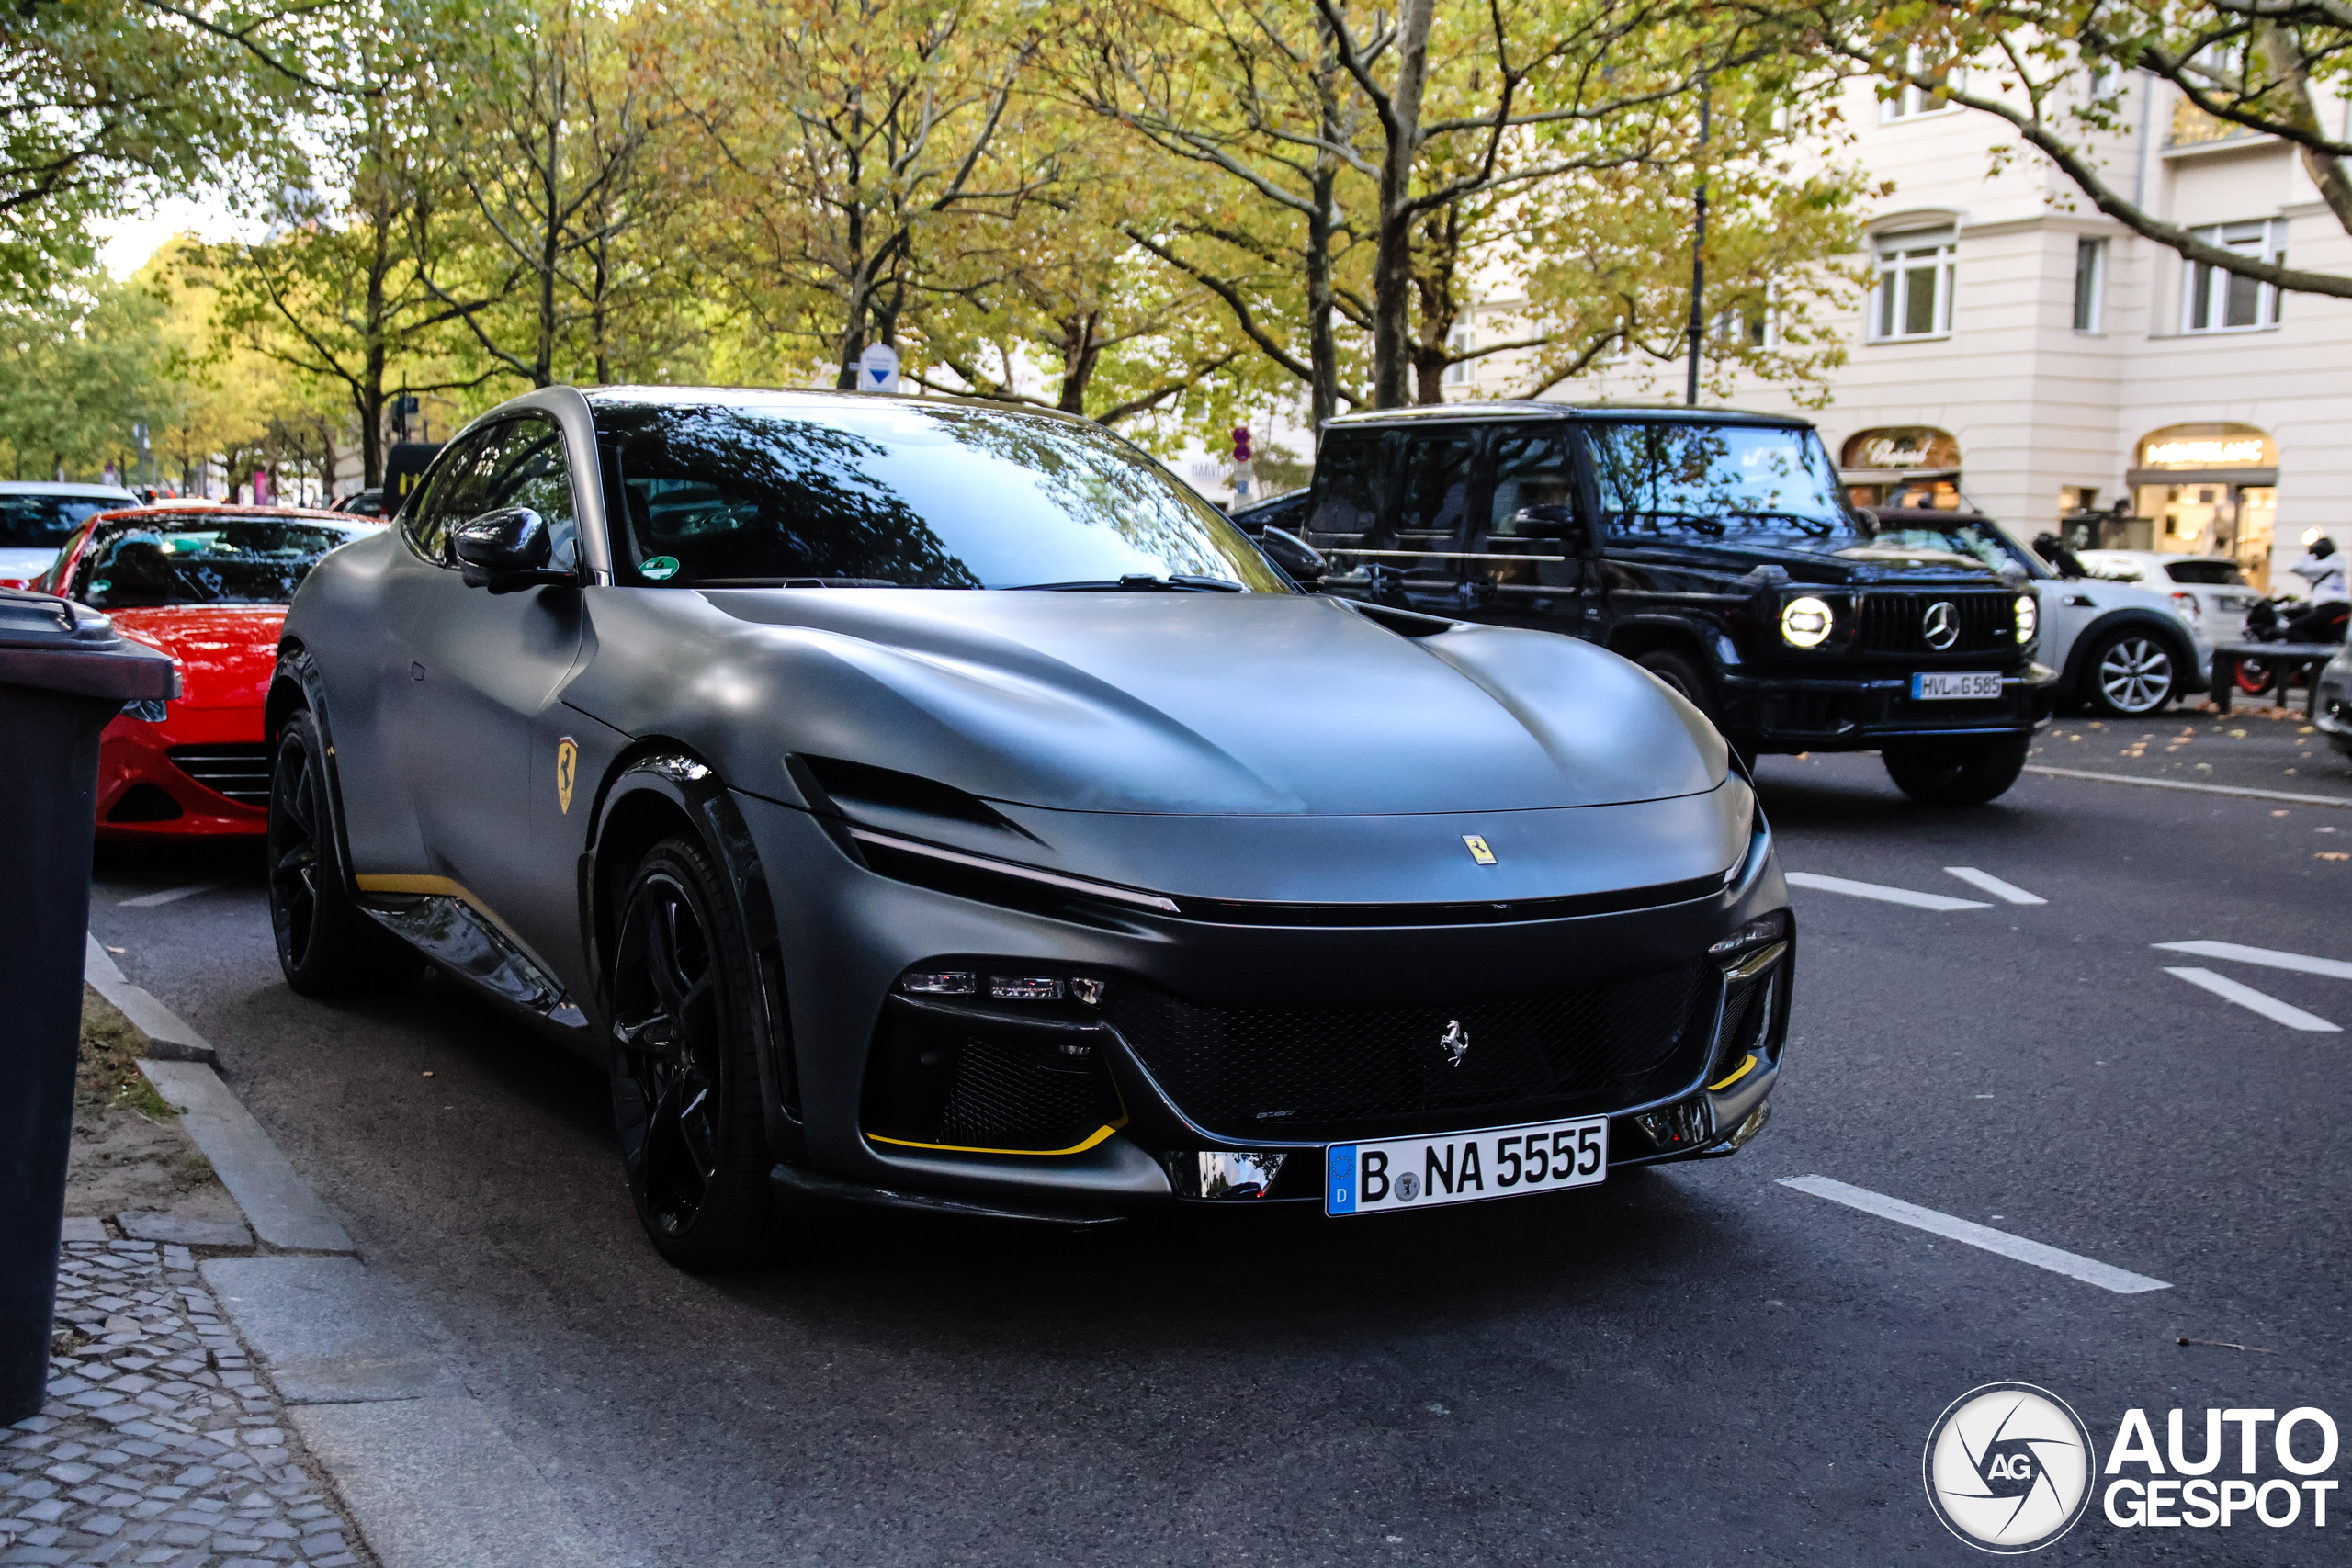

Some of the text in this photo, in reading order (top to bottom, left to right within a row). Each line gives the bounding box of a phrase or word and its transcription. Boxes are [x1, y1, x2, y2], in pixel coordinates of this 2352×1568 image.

[653, 558, 664, 569] 4
[1922, 675, 2001, 694] HVL G 585
[1361, 1150, 1390, 1203] B
[1425, 1141, 1484, 1197] NA
[1497, 1125, 1602, 1189] 5555
[1337, 1189, 1347, 1202] D
